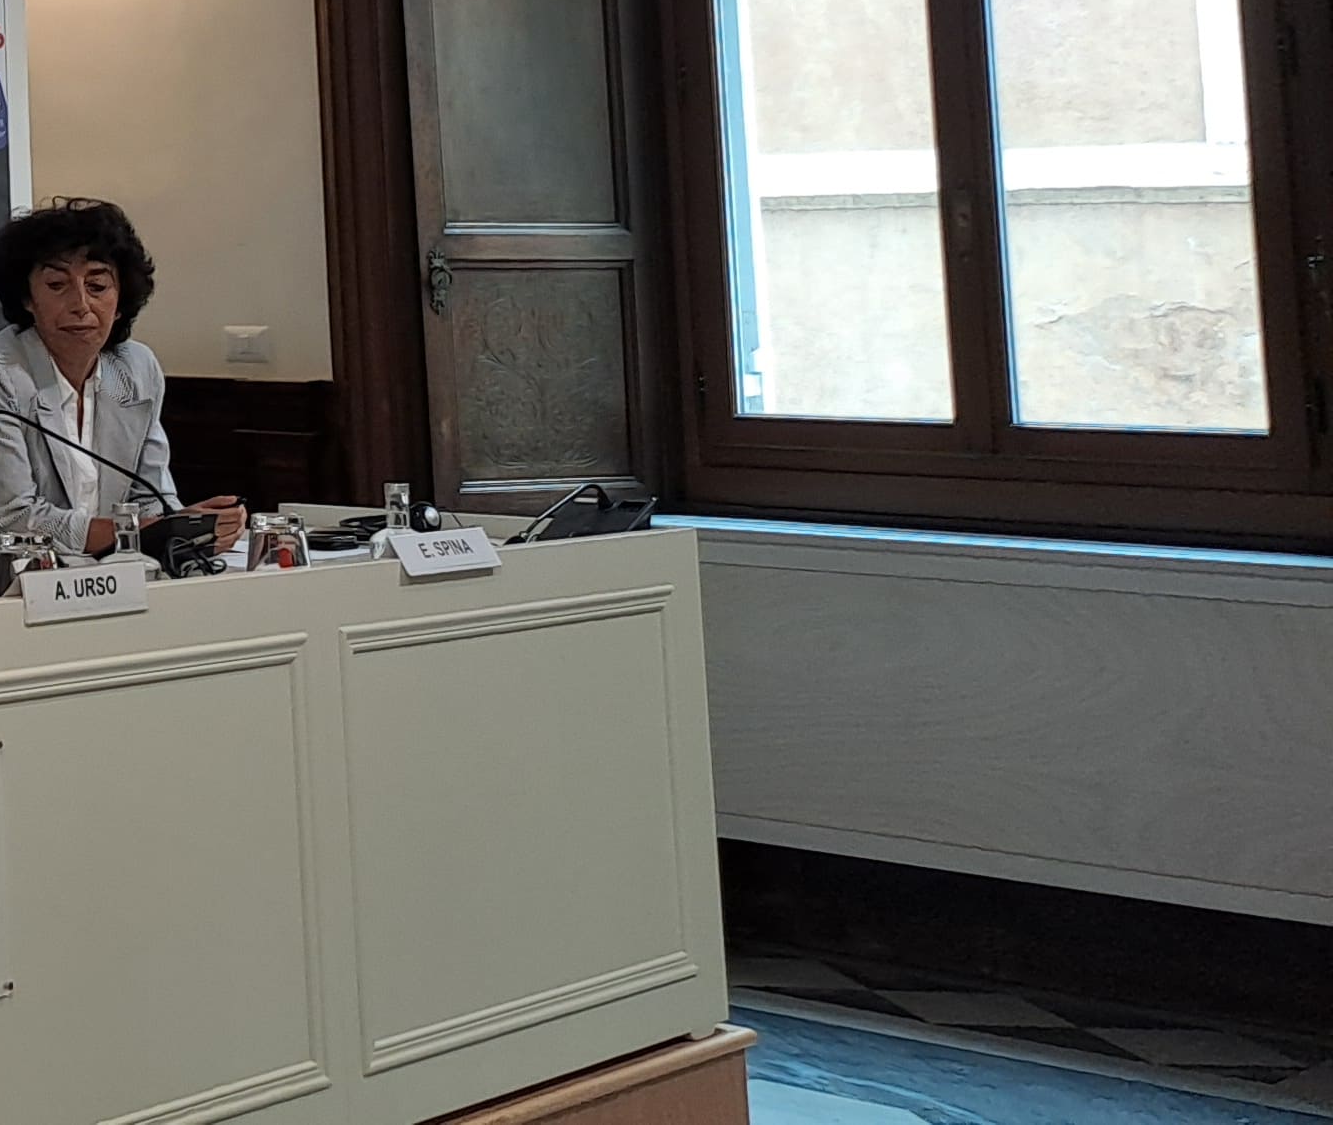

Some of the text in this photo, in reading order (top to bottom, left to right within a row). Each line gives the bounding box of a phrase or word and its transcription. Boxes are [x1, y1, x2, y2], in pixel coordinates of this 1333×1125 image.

[417, 538, 476, 559] E. SPINA
[54, 575, 118, 601] A. URSO
